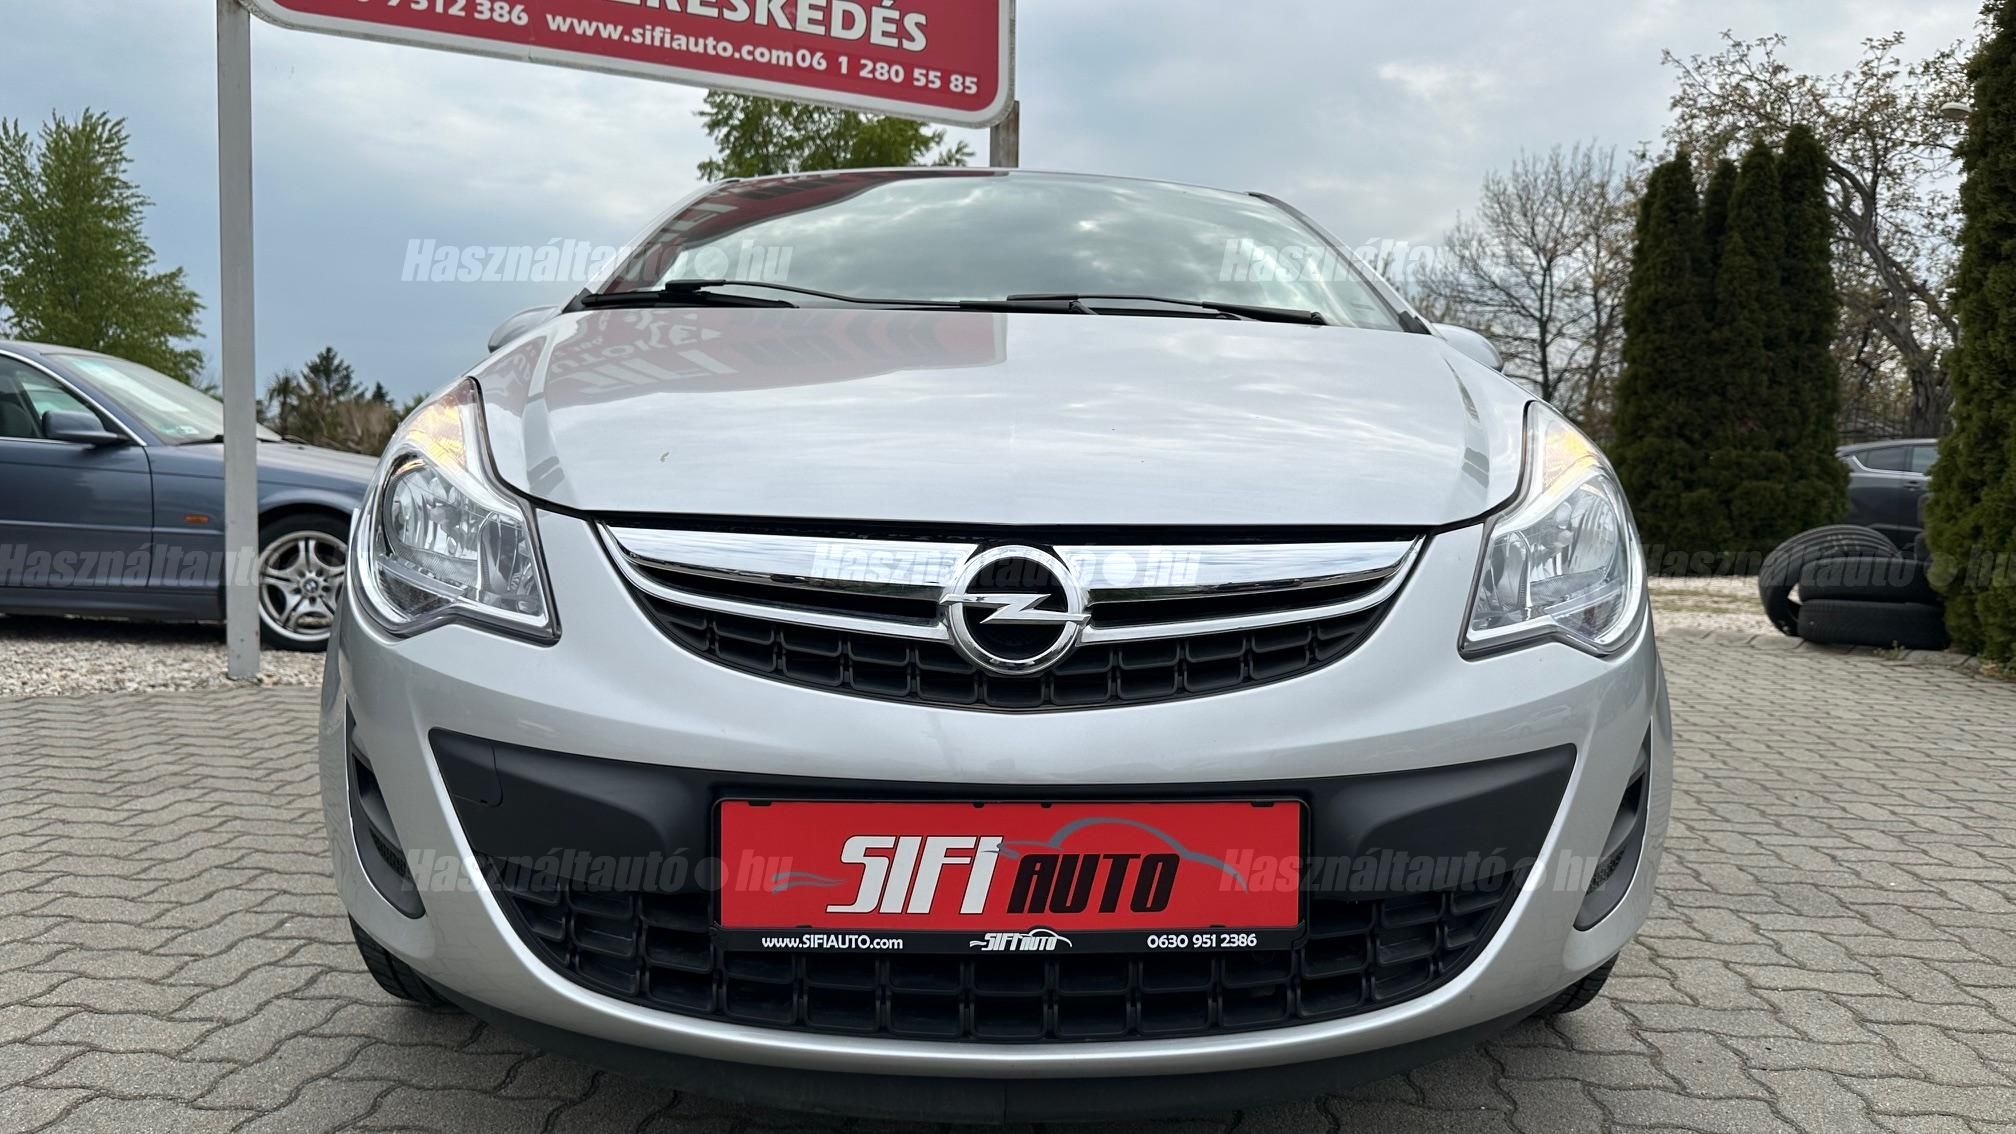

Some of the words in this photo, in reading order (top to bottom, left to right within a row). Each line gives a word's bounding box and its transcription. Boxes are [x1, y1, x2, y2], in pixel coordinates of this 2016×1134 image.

[473, 0, 529, 26] 386
[545, 13, 793, 67] www.sifiauto.com
[796, 49, 827, 71] 06
[838, 55, 848, 75] 1
[859, 59, 905, 83] 280
[913, 68, 942, 89] 55
[949, 74, 978, 95] 85
[825, 835, 1004, 914] SIFI
[1006, 853, 1181, 914] AUTO
[761, 933, 904, 950] www.SIFIAUTO.com
[1147, 934, 1189, 949] 0630
[1192, 934, 1217, 948] 951
[1220, 933, 1258, 948] 2386
